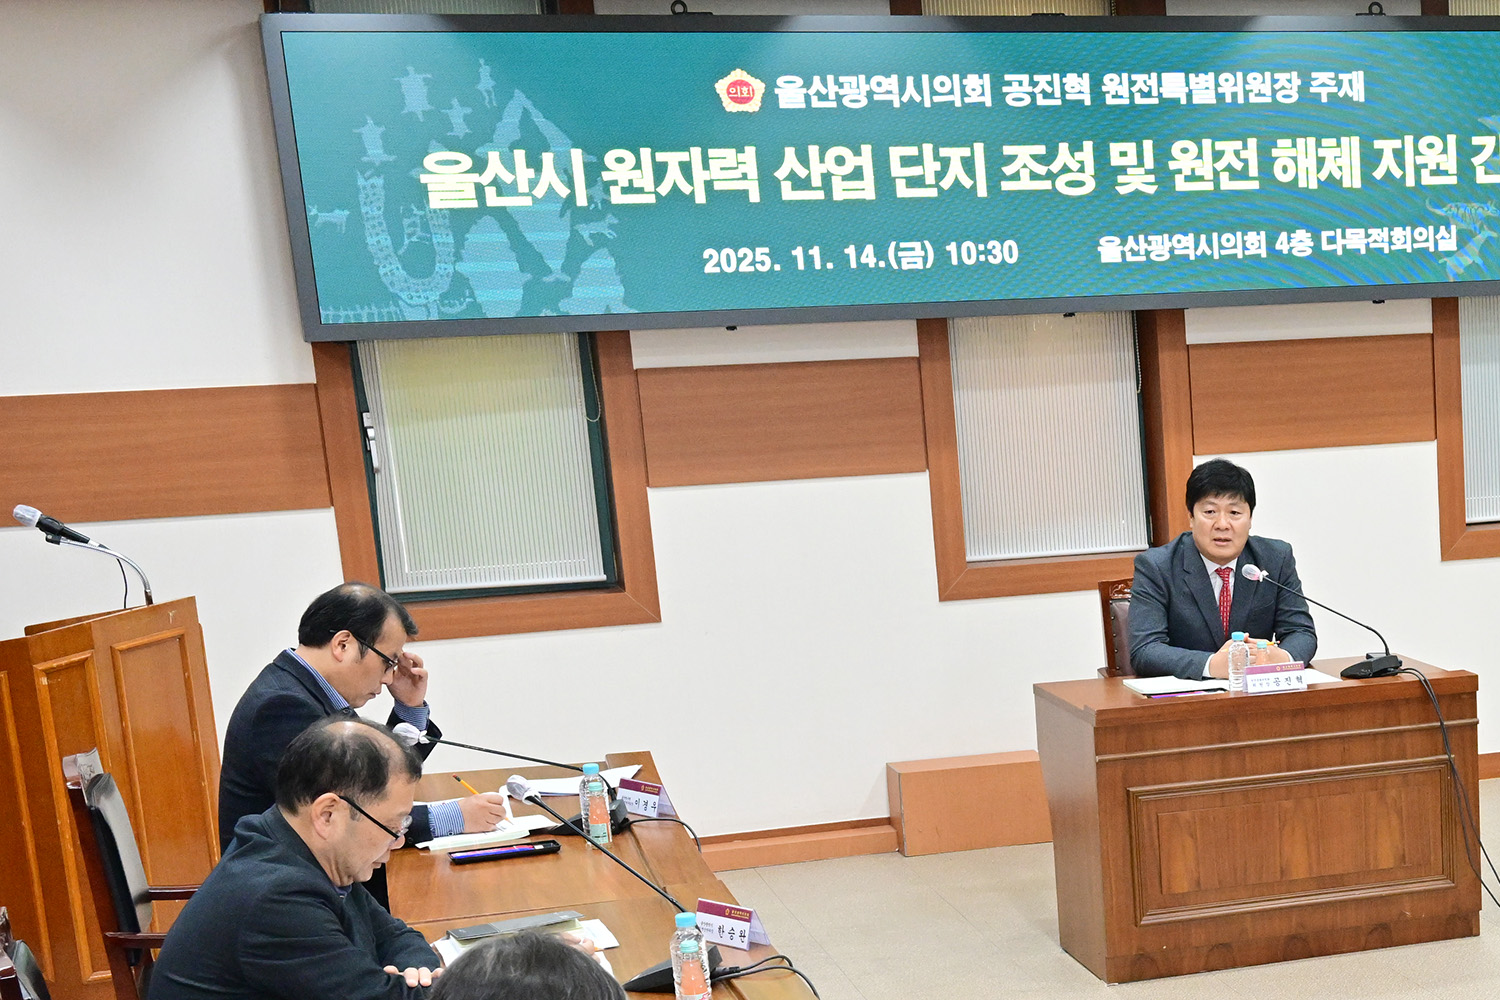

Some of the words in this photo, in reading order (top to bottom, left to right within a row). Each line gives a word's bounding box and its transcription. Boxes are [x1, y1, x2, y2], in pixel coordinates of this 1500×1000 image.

[728, 86, 753, 98] 의회
[774, 74, 992, 109] 울산광역시의회
[1002, 73, 1091, 107] 공진혁
[1101, 71, 1300, 104] 원전특별위원장
[1309, 71, 1365, 102] 주재
[419, 149, 588, 209] 울산시
[601, 146, 760, 204] 원자력
[774, 144, 876, 201] 산업
[889, 143, 987, 198] 단지
[1000, 140, 1096, 195] 조성
[1110, 140, 1158, 195] 및
[1168, 138, 1260, 191] 원전
[1272, 136, 1361, 189] 해체
[1373, 134, 1457, 187] 지원
[702, 247, 781, 274] 2025.
[791, 246, 833, 270] 11.
[844, 240, 934, 270] 14.(금)
[946, 240, 1018, 266] 10:30
[1097, 231, 1267, 263] 울산광역시의회
[1275, 229, 1314, 257] 4층
[1320, 225, 1458, 255] 다목적회의실
